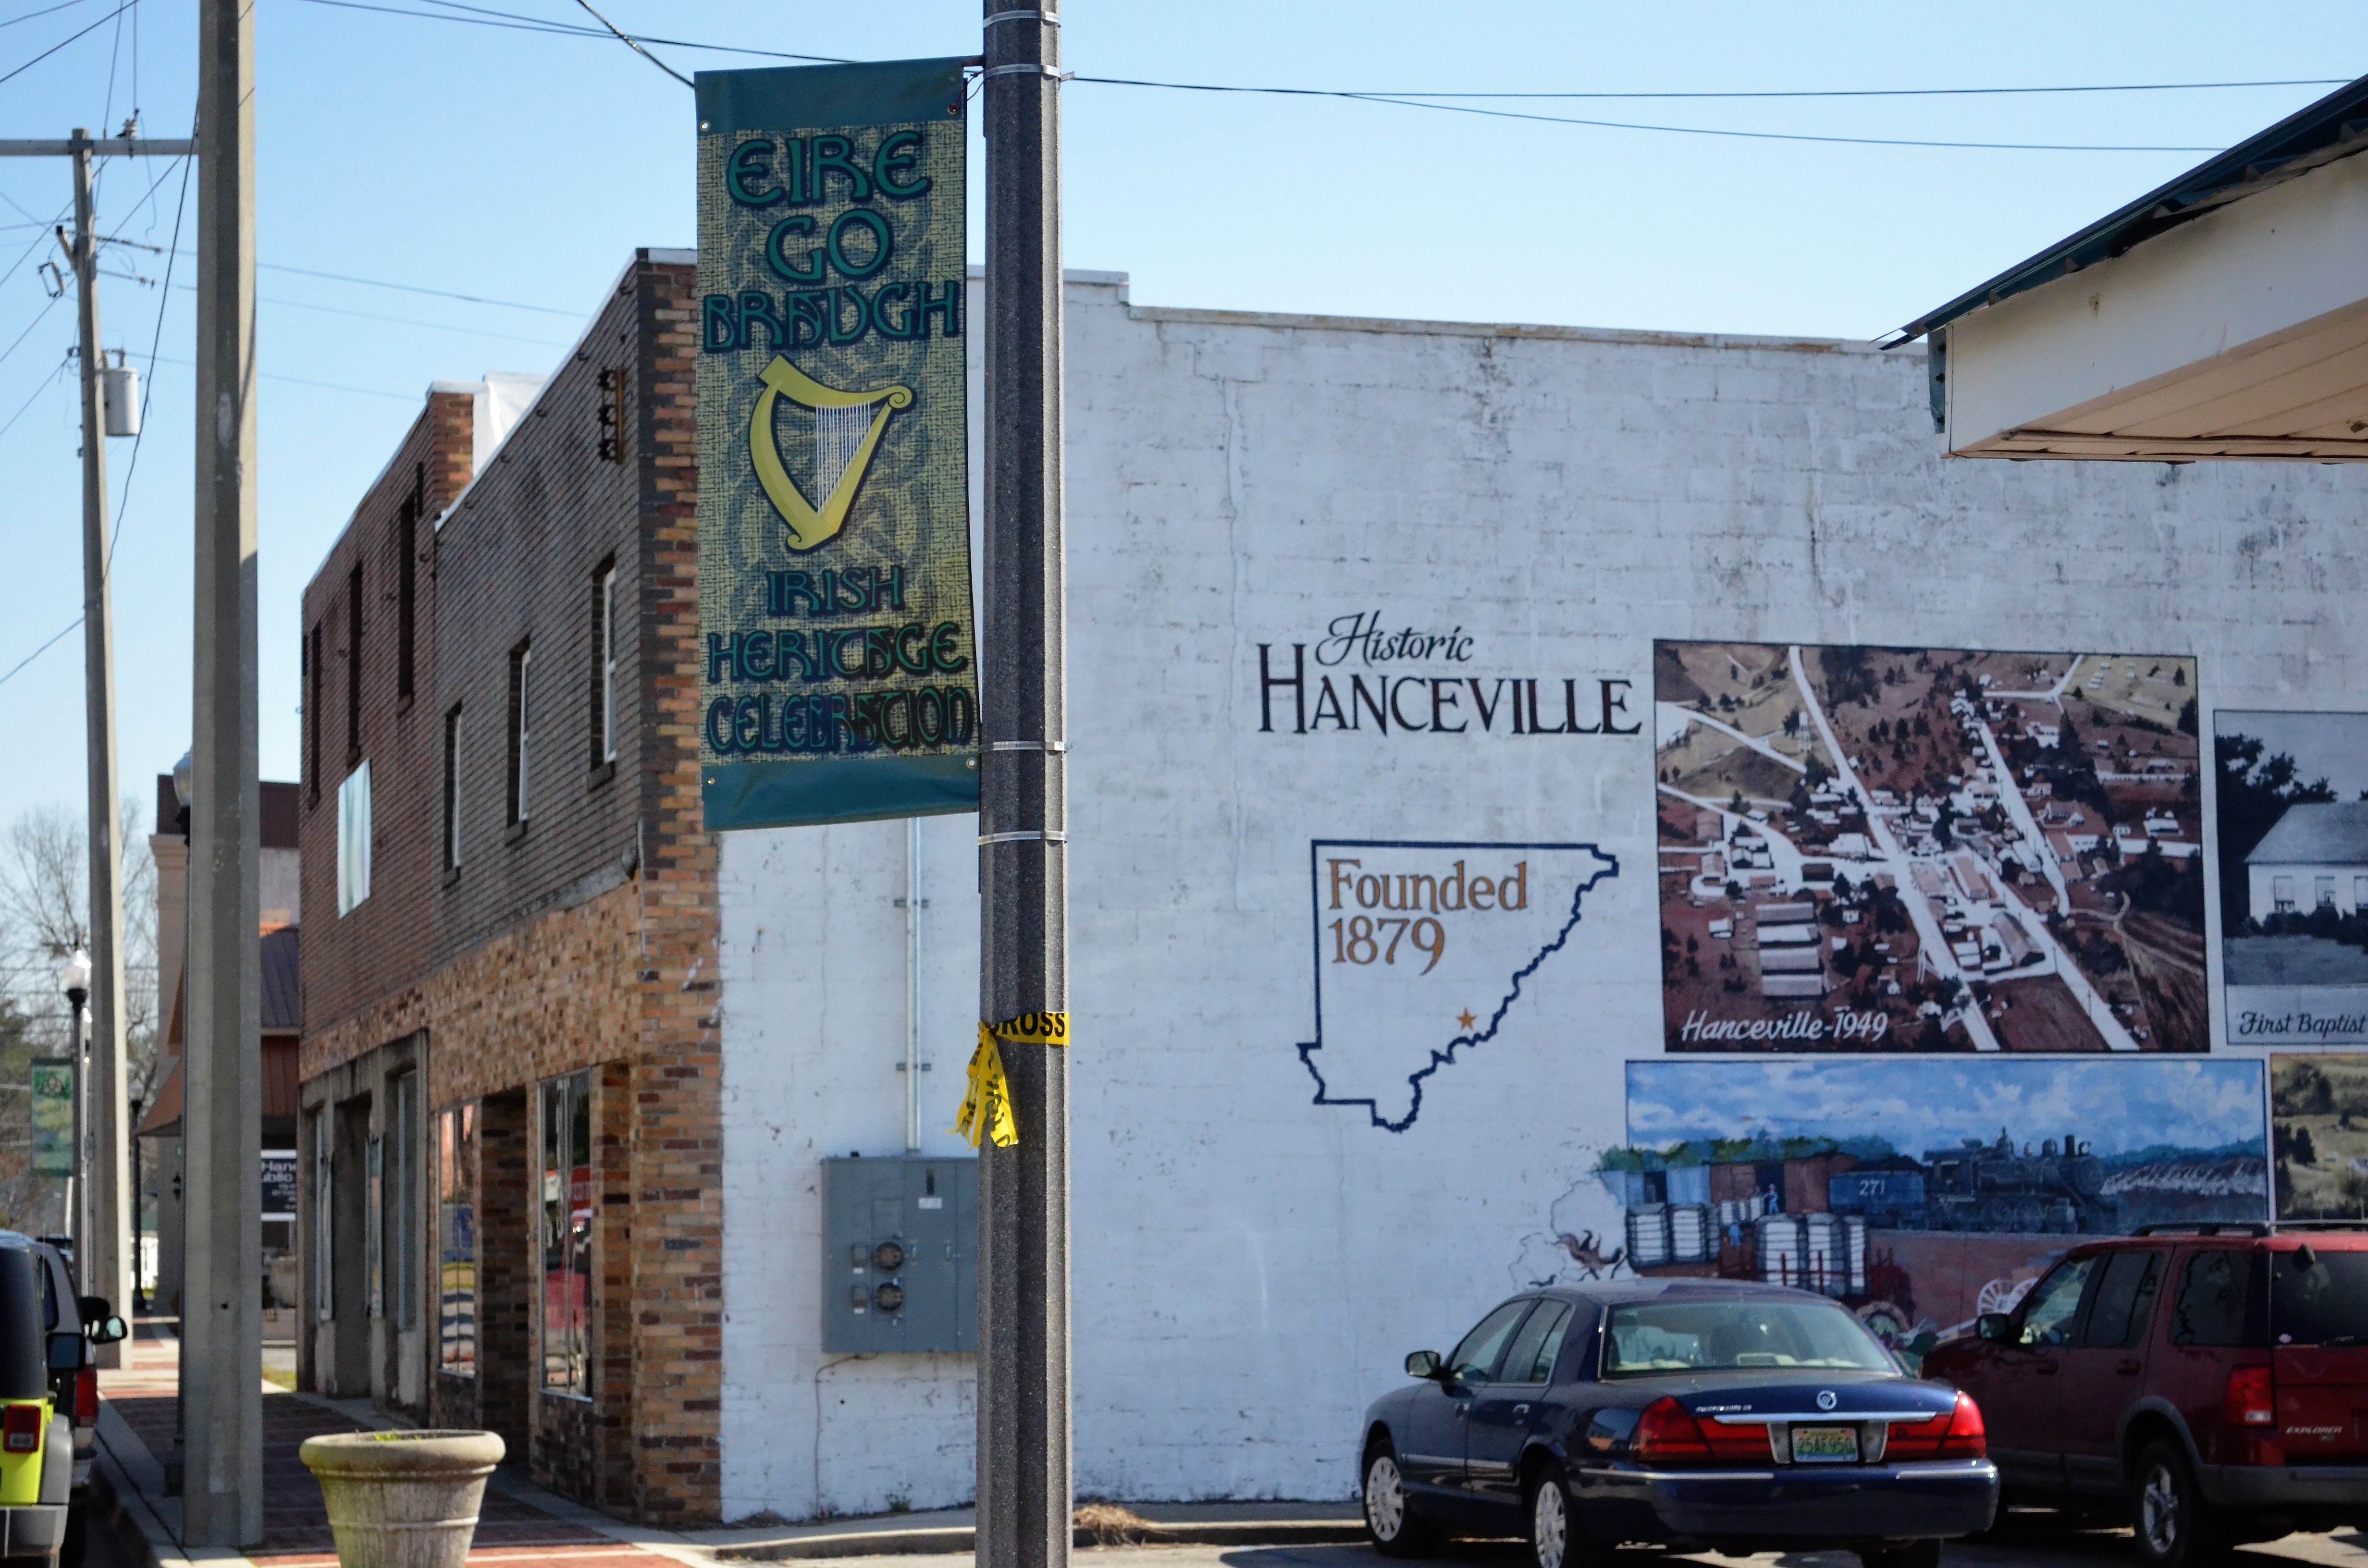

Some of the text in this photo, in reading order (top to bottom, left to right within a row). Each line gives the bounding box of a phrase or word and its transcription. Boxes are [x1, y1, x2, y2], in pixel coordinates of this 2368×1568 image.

[728, 131, 931, 207] EIRE
[767, 208, 893, 283] GO
[767, 567, 904, 617] IRISH
[708, 622, 968, 682] HERITAGE
[1315, 610, 1474, 667] Historic
[1257, 643, 1642, 736] HANCEVILLE
[706, 686, 975, 754] CELEBRATION
[1327, 858, 1528, 914] Founded
[1328, 917, 1445, 976] 1879
[2239, 1010, 2367, 1040] First Baptist
[1859, 1179, 1885, 1196] 271
